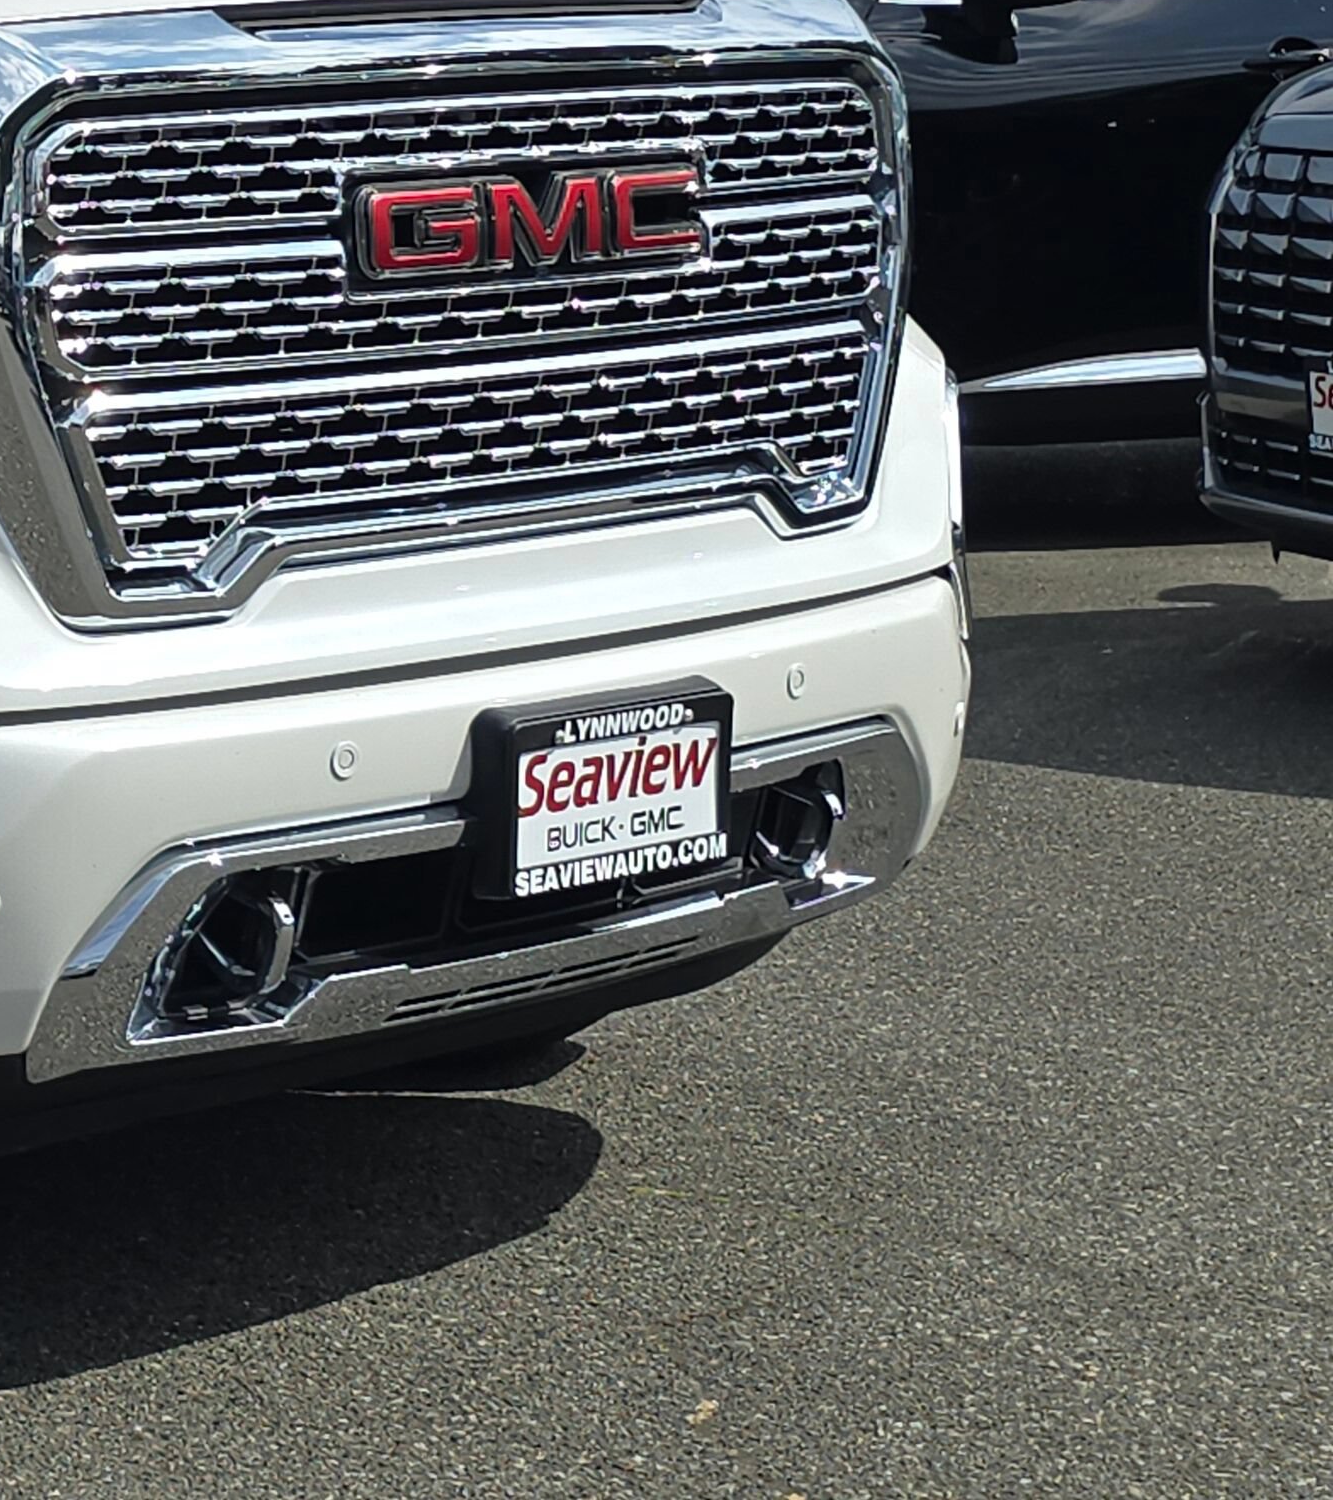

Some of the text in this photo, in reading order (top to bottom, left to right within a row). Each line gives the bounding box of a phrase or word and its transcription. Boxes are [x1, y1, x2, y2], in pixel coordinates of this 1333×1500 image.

[359, 167, 705, 279] GMC
[563, 703, 685, 744] LYNNWOOD
[518, 736, 718, 818] Seaview
[547, 806, 685, 852] BUICK GMC
[515, 833, 728, 897] SEAVIEWAUTO.COM
